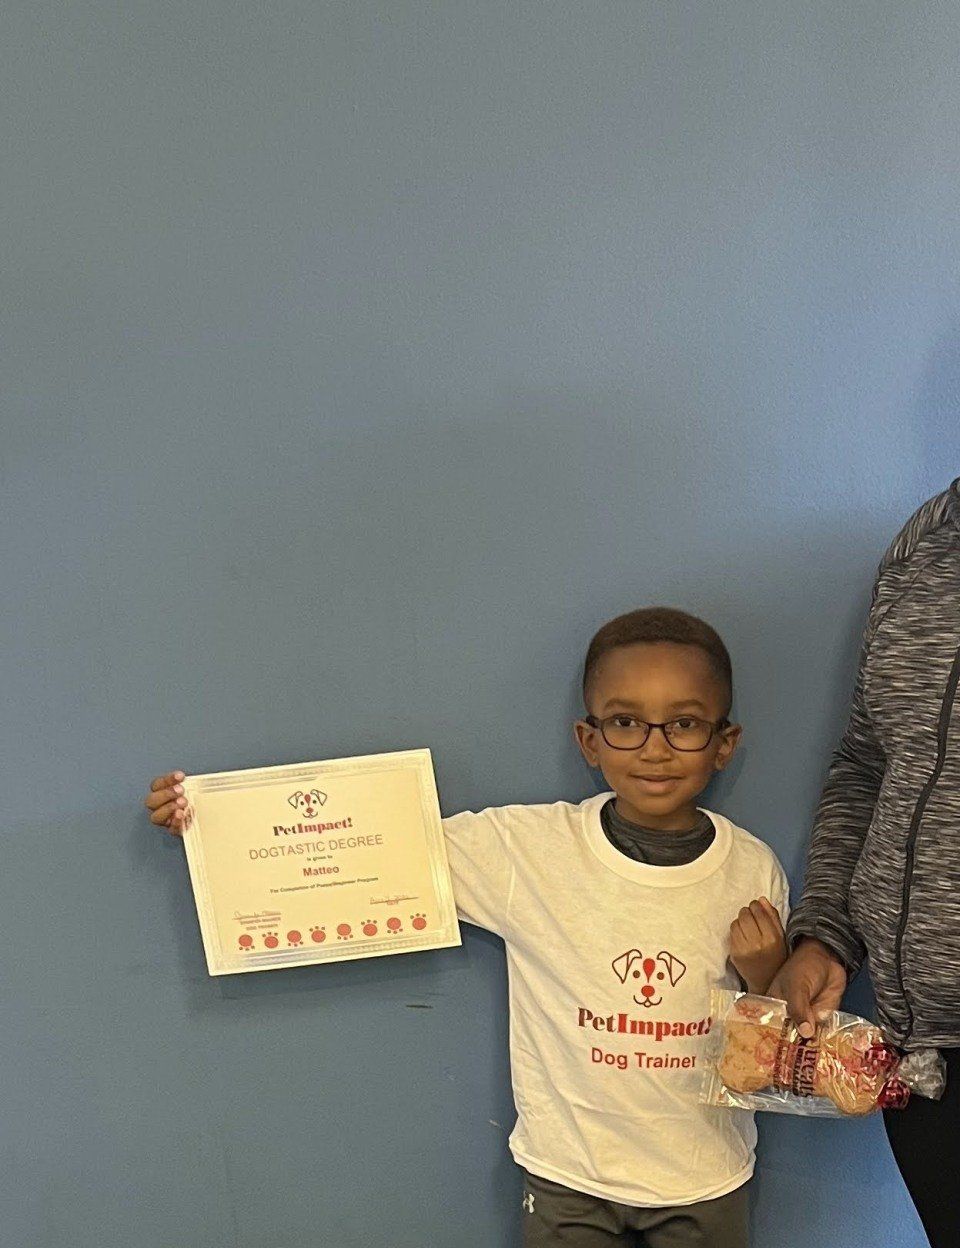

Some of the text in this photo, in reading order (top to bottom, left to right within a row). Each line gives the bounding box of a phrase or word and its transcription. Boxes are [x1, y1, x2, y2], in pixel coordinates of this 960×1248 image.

[272, 818, 353, 836] PetImpact!
[249, 834, 384, 860] DOGTASTIC DEGREE
[302, 866, 340, 877] Matteo
[578, 1007, 711, 1041] PetImpact!
[591, 1047, 697, 1070] Dog Trainer
